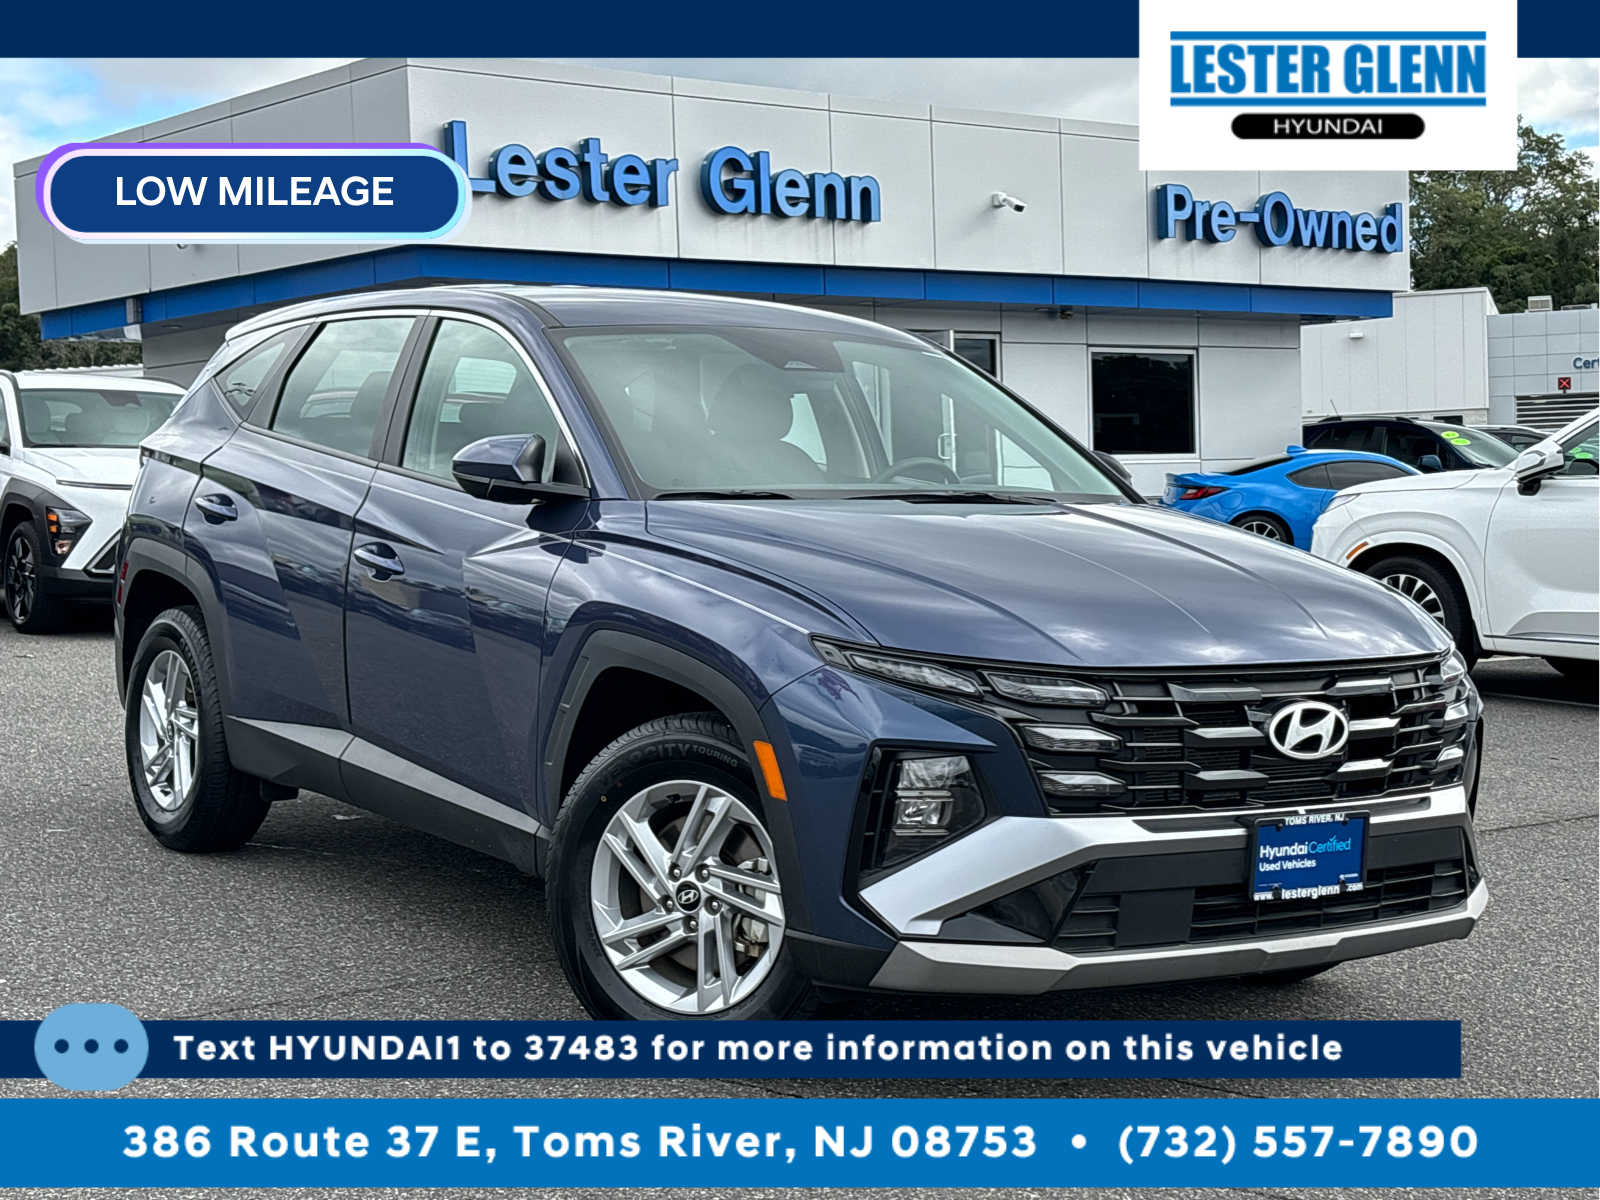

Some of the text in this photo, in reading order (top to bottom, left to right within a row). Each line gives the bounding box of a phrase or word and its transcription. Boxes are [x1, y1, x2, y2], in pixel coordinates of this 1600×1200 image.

[443, 120, 881, 222] Lester Glenn
[1157, 184, 1403, 253] Pre-Owned
[693, 744, 738, 768] TOURING
[1284, 815, 1307, 826] TOMS
[1335, 813, 1345, 822] NJ
[1258, 858, 1317, 872] Used Vehicles
[1281, 884, 1340, 900] lesterglenn
